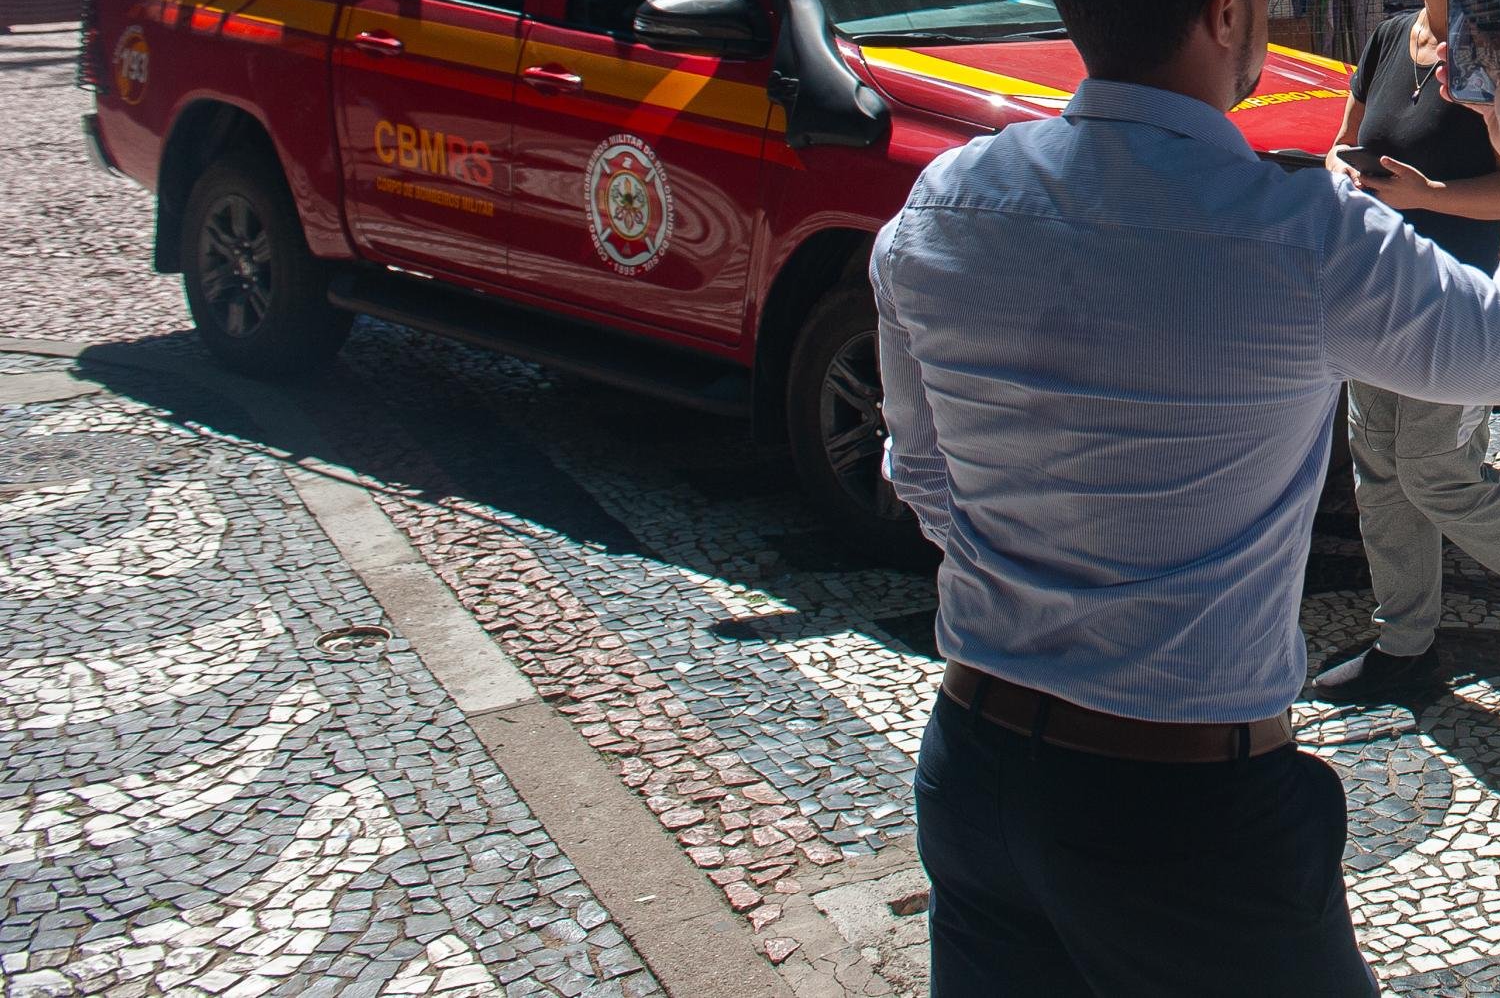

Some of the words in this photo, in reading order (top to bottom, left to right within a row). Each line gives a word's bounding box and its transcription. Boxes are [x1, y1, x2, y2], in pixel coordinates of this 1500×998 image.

[122, 50, 149, 83] 193
[375, 120, 493, 186] CBMRS
[608, 133, 644, 149] MILITAR
[583, 140, 610, 201] BOMBEIROS
[654, 160, 667, 181] RIO
[376, 176, 403, 195] CORPO
[403, 182, 414, 198] DE
[415, 185, 460, 210] BOMBEIROS
[461, 193, 495, 218] MILITAR
[663, 185, 675, 238] GRANDE
[589, 224, 609, 262] CORPO
[643, 255, 660, 272] SUL
